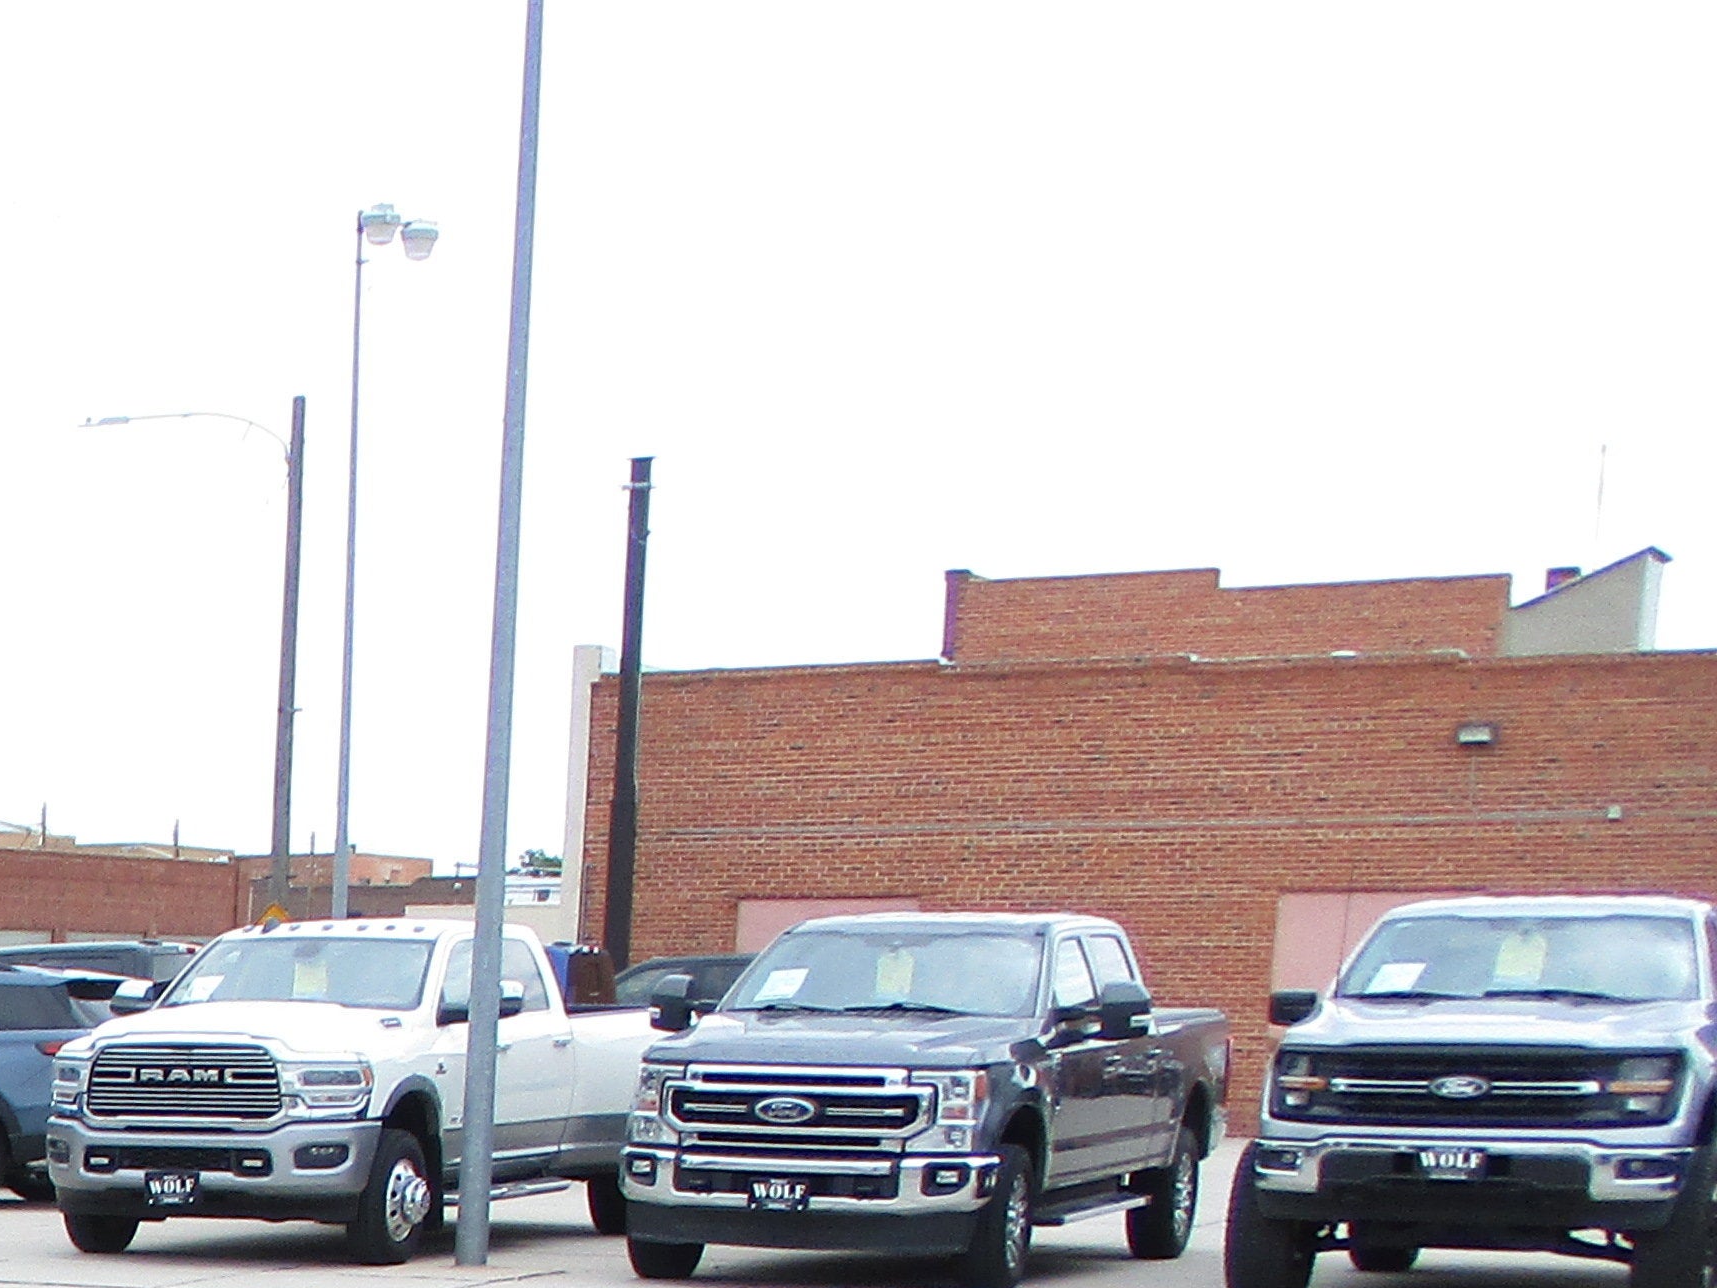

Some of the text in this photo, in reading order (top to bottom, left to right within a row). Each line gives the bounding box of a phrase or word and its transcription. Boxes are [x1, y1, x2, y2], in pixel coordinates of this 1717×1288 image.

[139, 1067, 220, 1083] RAM
[1419, 1151, 1483, 1169] WOLF
[148, 1177, 196, 1195] WOLF
[752, 1182, 807, 1199] WOLF
